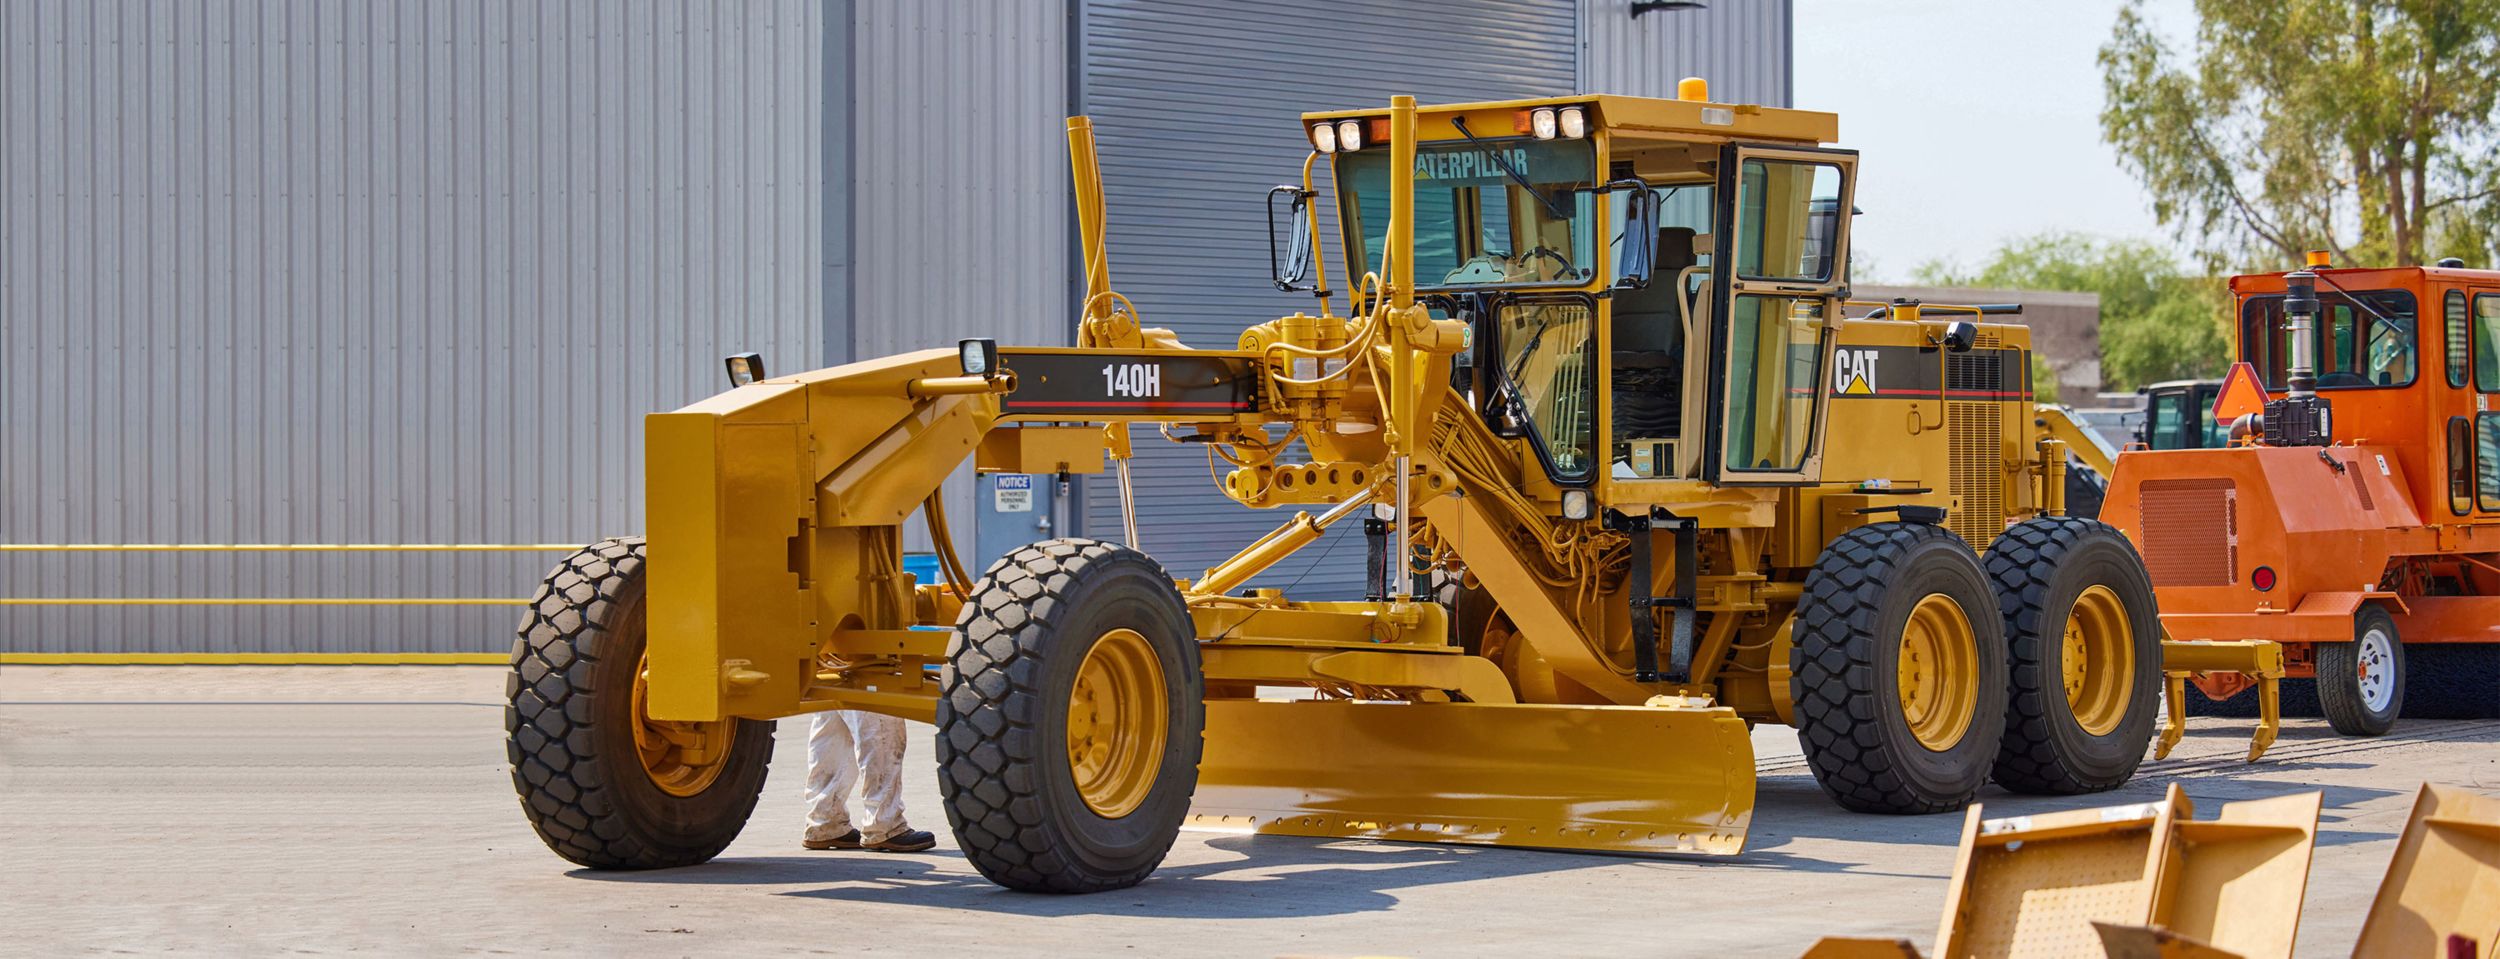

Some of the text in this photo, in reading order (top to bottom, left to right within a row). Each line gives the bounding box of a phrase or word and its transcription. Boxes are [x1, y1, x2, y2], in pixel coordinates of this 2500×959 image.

[1414, 149, 1528, 179] ATERPILLAR
[1102, 364, 1161, 398] 140H
[1835, 349, 1879, 394] CAT
[998, 476, 1028, 489] NOTICE
